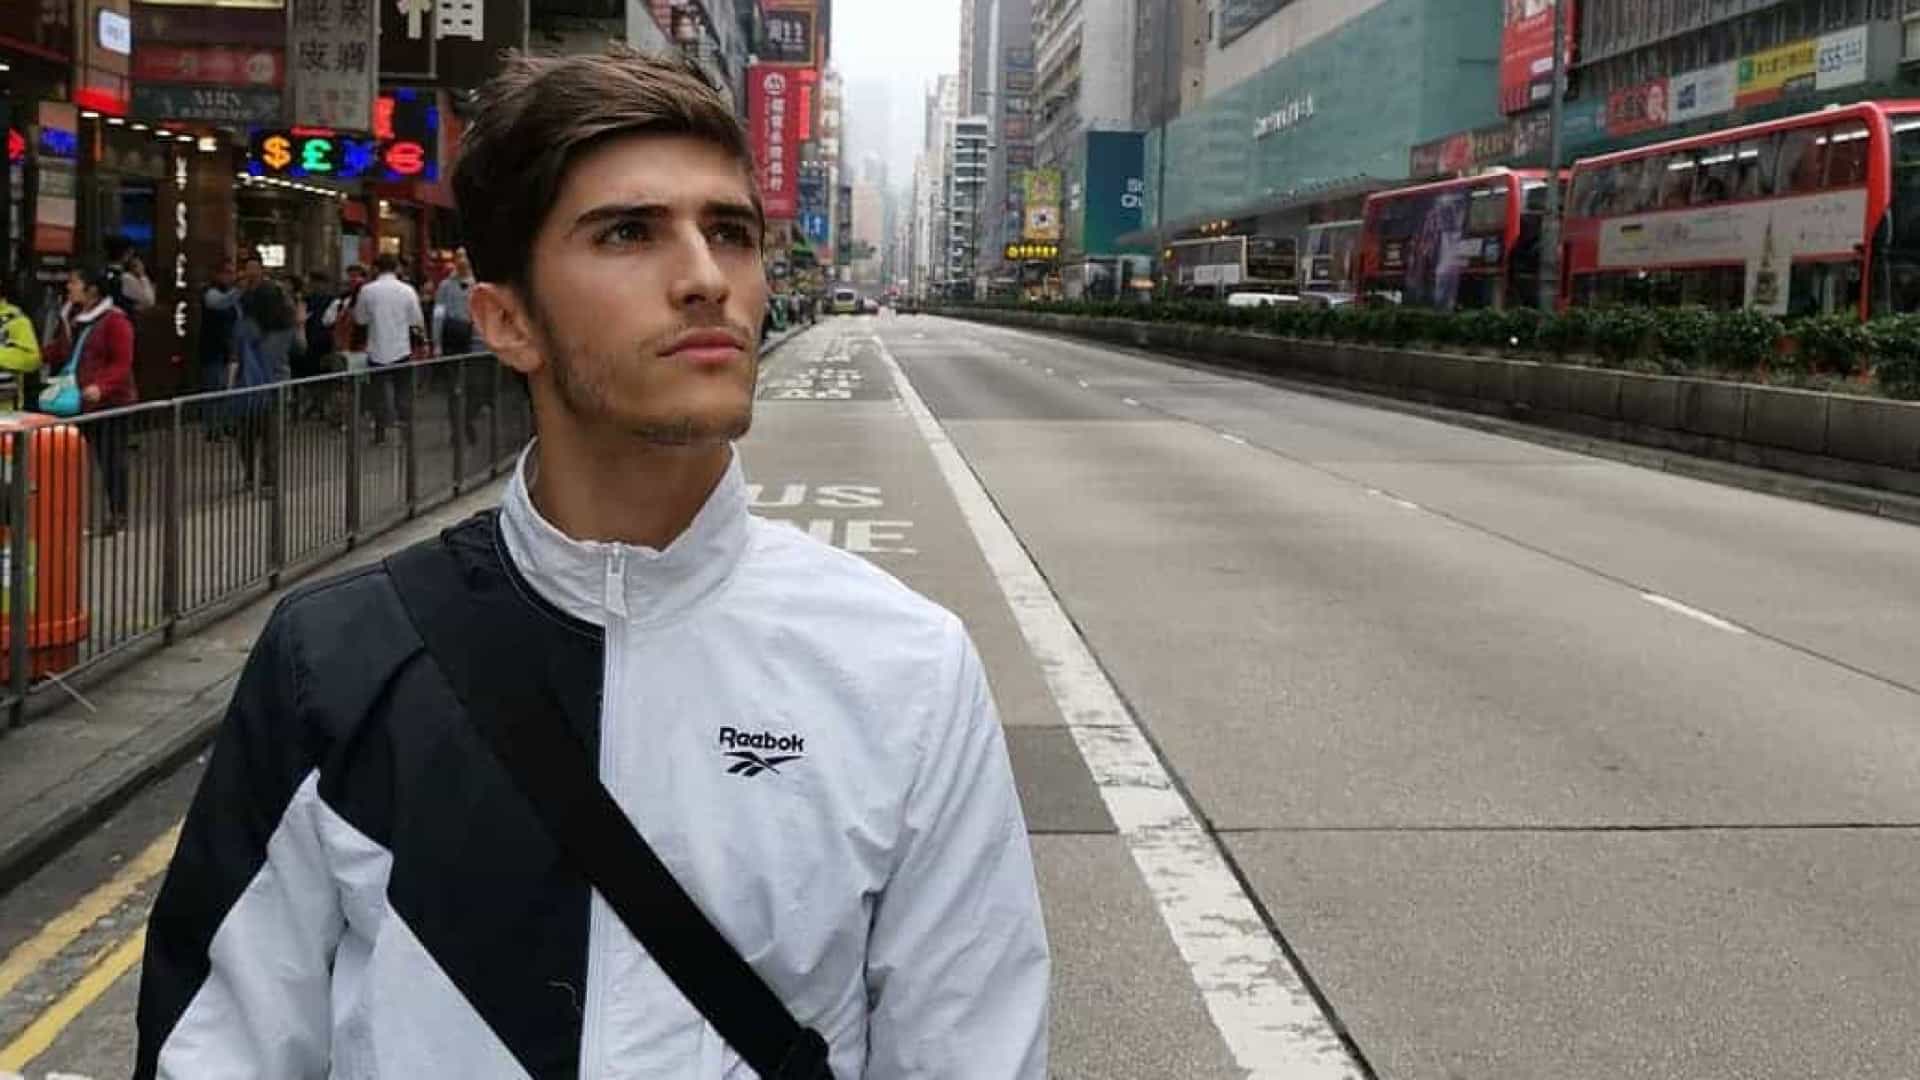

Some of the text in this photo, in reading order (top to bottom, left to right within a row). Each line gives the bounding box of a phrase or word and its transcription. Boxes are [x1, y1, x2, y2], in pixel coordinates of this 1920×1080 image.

[263, 136, 291, 170] $
[302, 139, 332, 171] £
[747, 484, 883, 507] US
[719, 726, 804, 751] Reebok
